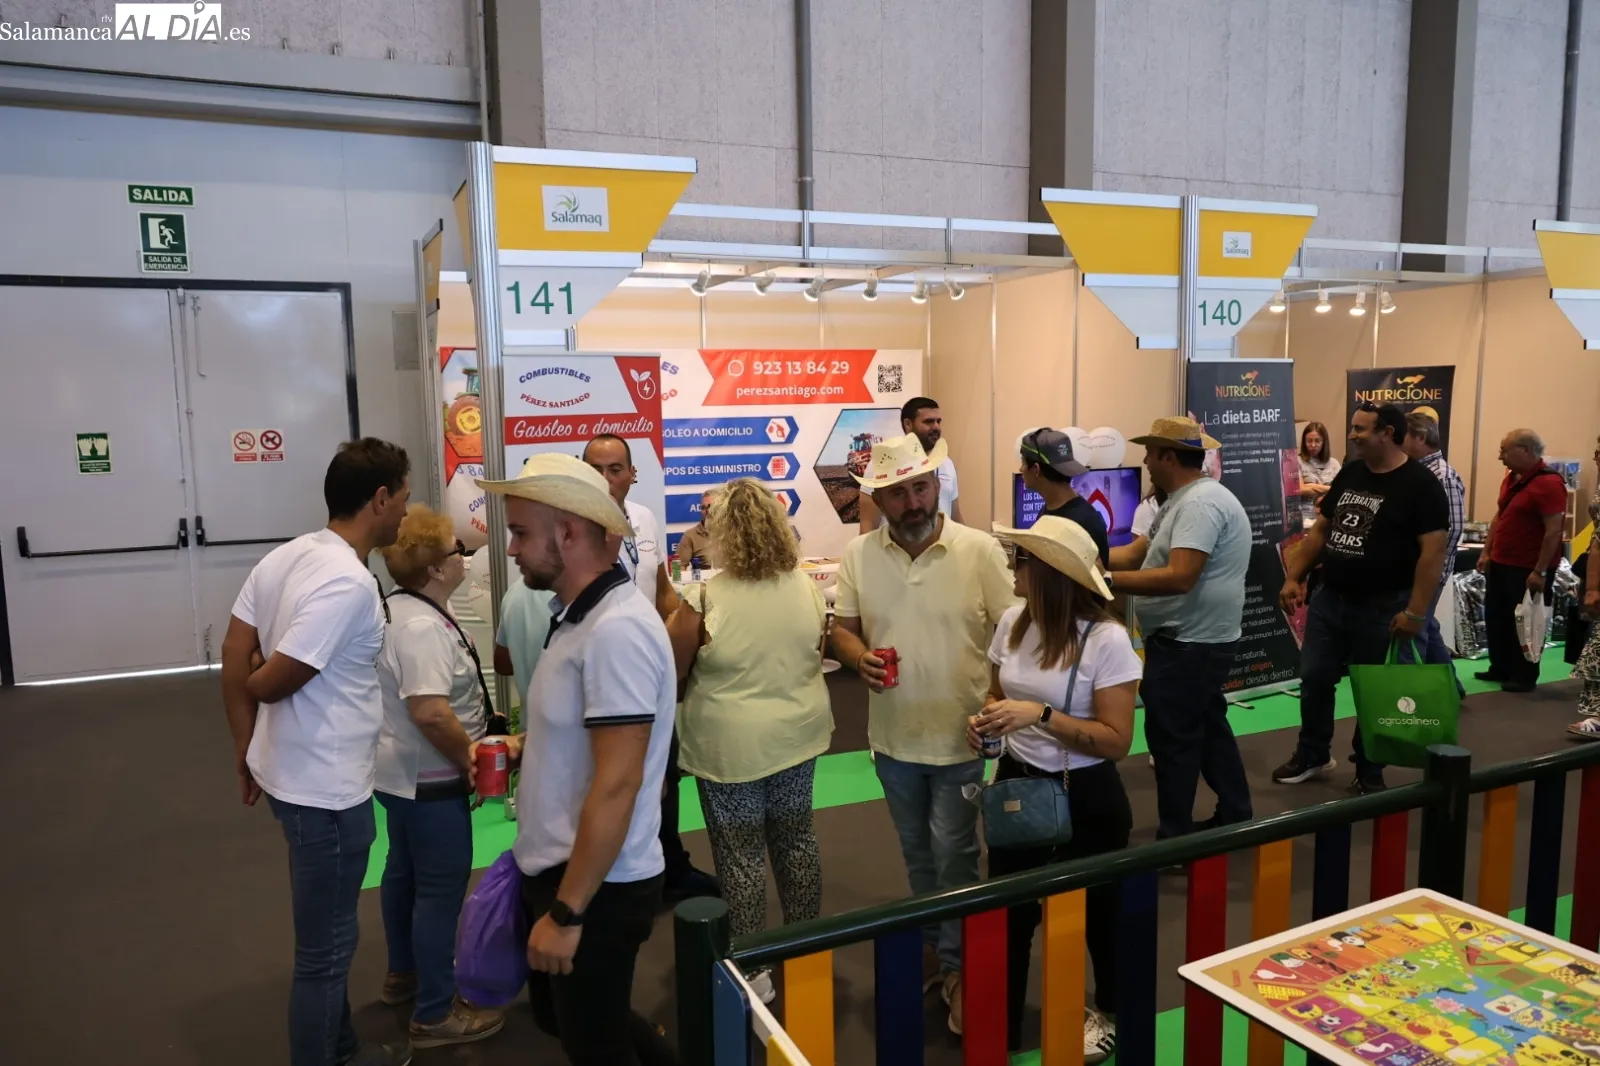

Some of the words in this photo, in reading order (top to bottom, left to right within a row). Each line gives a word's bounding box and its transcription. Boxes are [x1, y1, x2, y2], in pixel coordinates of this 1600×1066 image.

[132, 188, 190, 202] SALIDA
[551, 210, 602, 227] Salamaq
[144, 262, 188, 270] EMERGENCIA
[506, 280, 572, 314] 141
[1198, 299, 1242, 326] 140
[753, 361, 782, 374] 923
[786, 361, 802, 374] 13
[806, 361, 827, 374] 84
[831, 361, 849, 374] 29
[519, 367, 591, 383] COMBUSTIBLES
[736, 384, 844, 398] perezsantiago.com
[1216, 384, 1271, 398] NUTRICIONE
[1355, 386, 1443, 402] NUTRICIONE
[520, 393, 547, 408] PÉREZ
[549, 392, 590, 408] SANTIAGO
[1204, 411, 1220, 426] La
[1222, 410, 1250, 424] dieta
[514, 419, 572, 438] Gasóleo
[578, 424, 588, 435] a
[592, 416, 654, 434] domicilio
[662, 426, 691, 437] ÓLEO
[693, 428, 700, 437] A
[701, 427, 753, 437] DOMICILIO
[688, 467, 700, 475] DE
[702, 464, 761, 474] SUMINISTRO
[1023, 502, 1034, 512] CON
[1337, 492, 1384, 514] CELEBRATING
[1342, 513, 1360, 527] 23
[1330, 530, 1364, 547] YEARS
[1242, 648, 1266, 660] natural,
[1246, 674, 1268, 685] desde
[1378, 715, 1440, 726] agrosalinero
